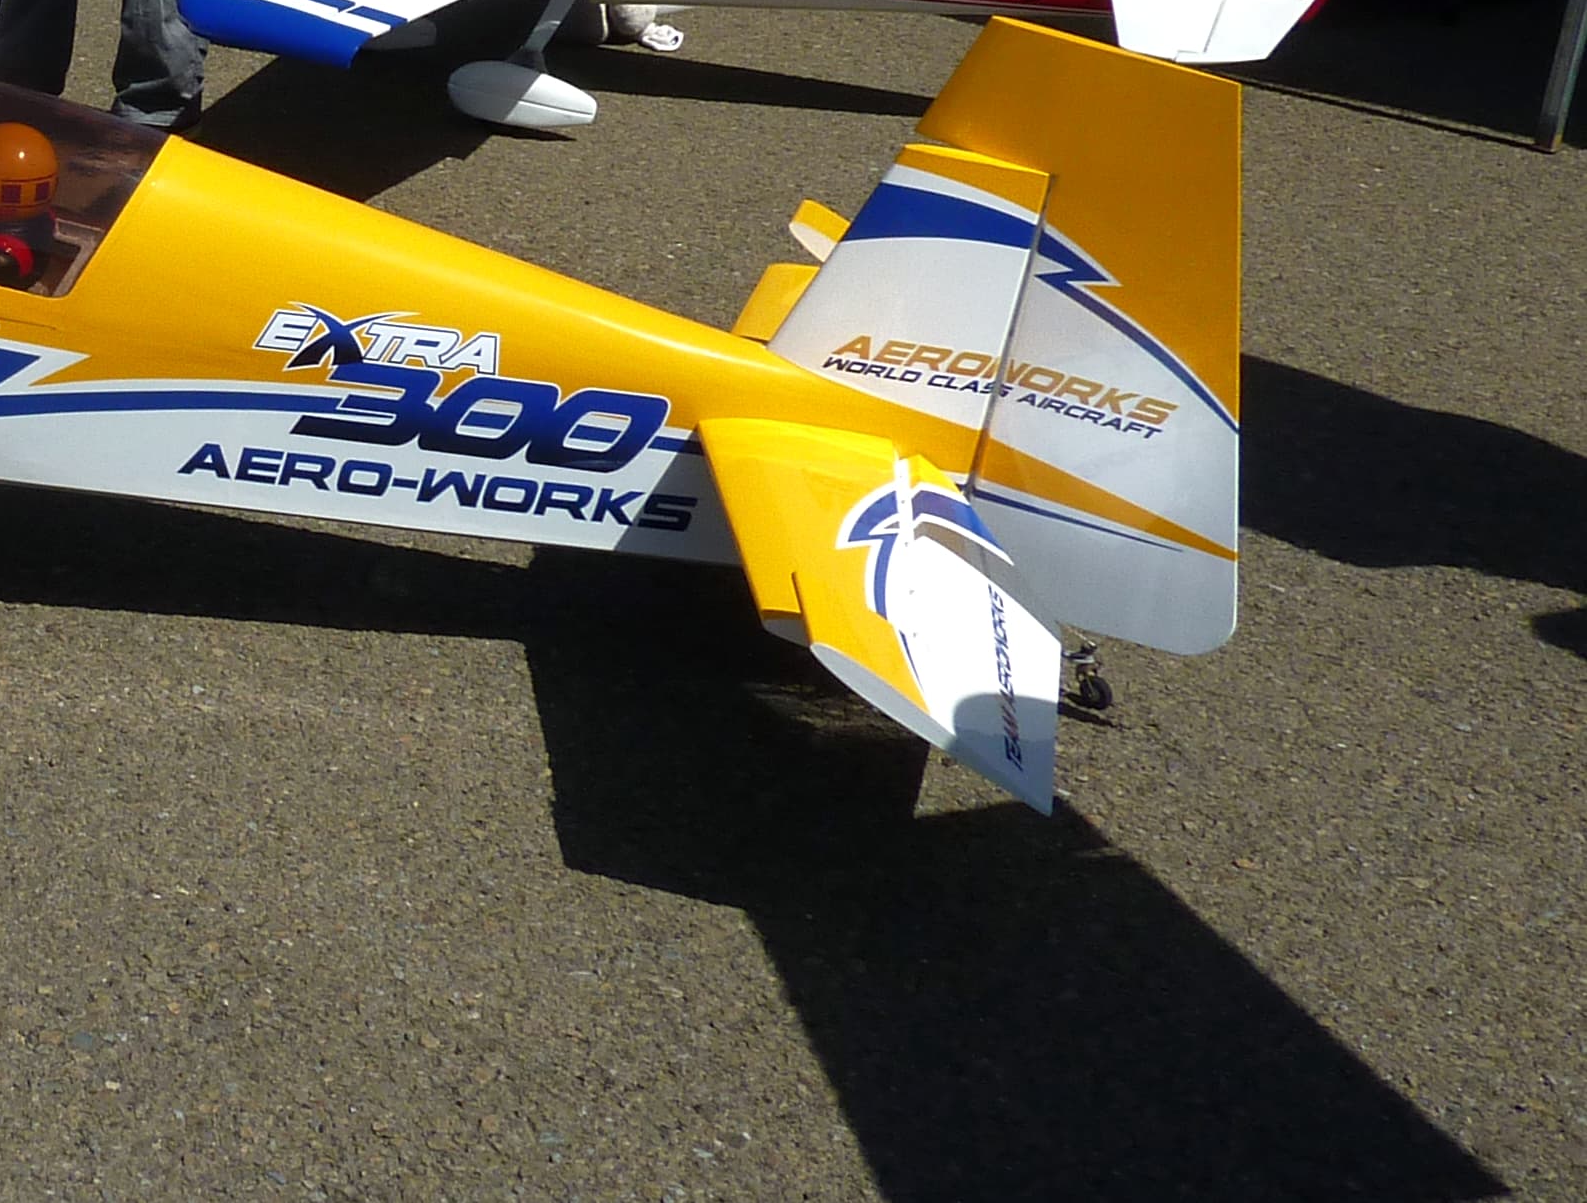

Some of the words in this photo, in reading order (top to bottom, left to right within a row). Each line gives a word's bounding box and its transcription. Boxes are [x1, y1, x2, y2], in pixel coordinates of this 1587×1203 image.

[253, 301, 500, 375] EXTRA
[289, 359, 670, 474] 300
[822, 356, 920, 384] WORLD
[1017, 393, 1163, 439] AIRCRAFT
[177, 443, 698, 532] AERO-WORKS
